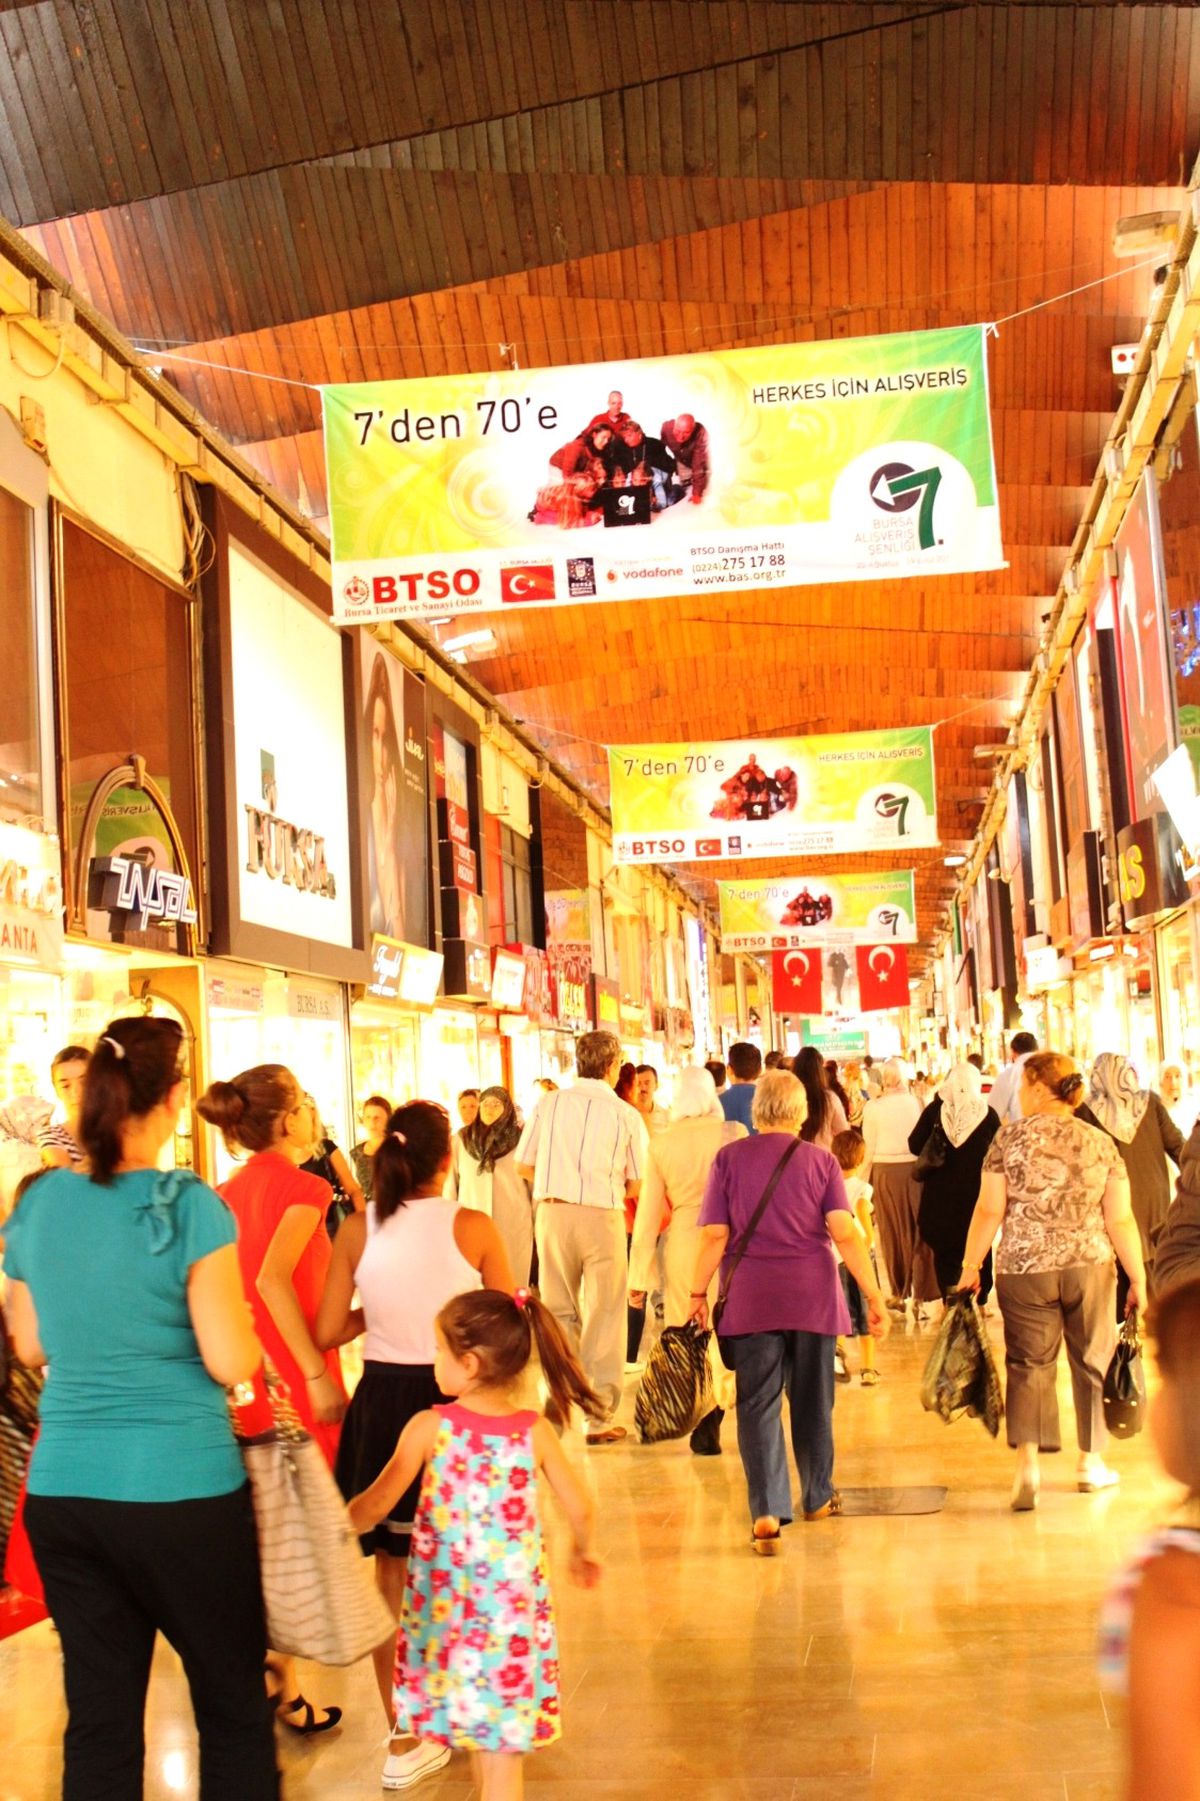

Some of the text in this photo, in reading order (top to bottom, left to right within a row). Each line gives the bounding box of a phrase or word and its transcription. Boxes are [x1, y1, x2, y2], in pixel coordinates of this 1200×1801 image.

[753, 367, 967, 403] HERKES İÇİN ALIŞVERİŞ
[354, 397, 558, 445] 7'den 70'e
[873, 517, 913, 529] BURSA
[690, 547, 715, 556] BTSO
[722, 556, 745, 570] 275
[750, 555, 765, 568] 17
[769, 554, 785, 567] 88
[623, 566, 684, 580] vodafone
[693, 569, 786, 585] www.bas.org.tr
[372, 568, 481, 604] BTSO
[344, 608, 372, 617] Bursa
[375, 605, 407, 615] Ticaret
[422, 601, 453, 612] Sanayi
[819, 752, 855, 762] HERKES
[632, 839, 685, 856] BTSO
[734, 936, 766, 947] BTSO
